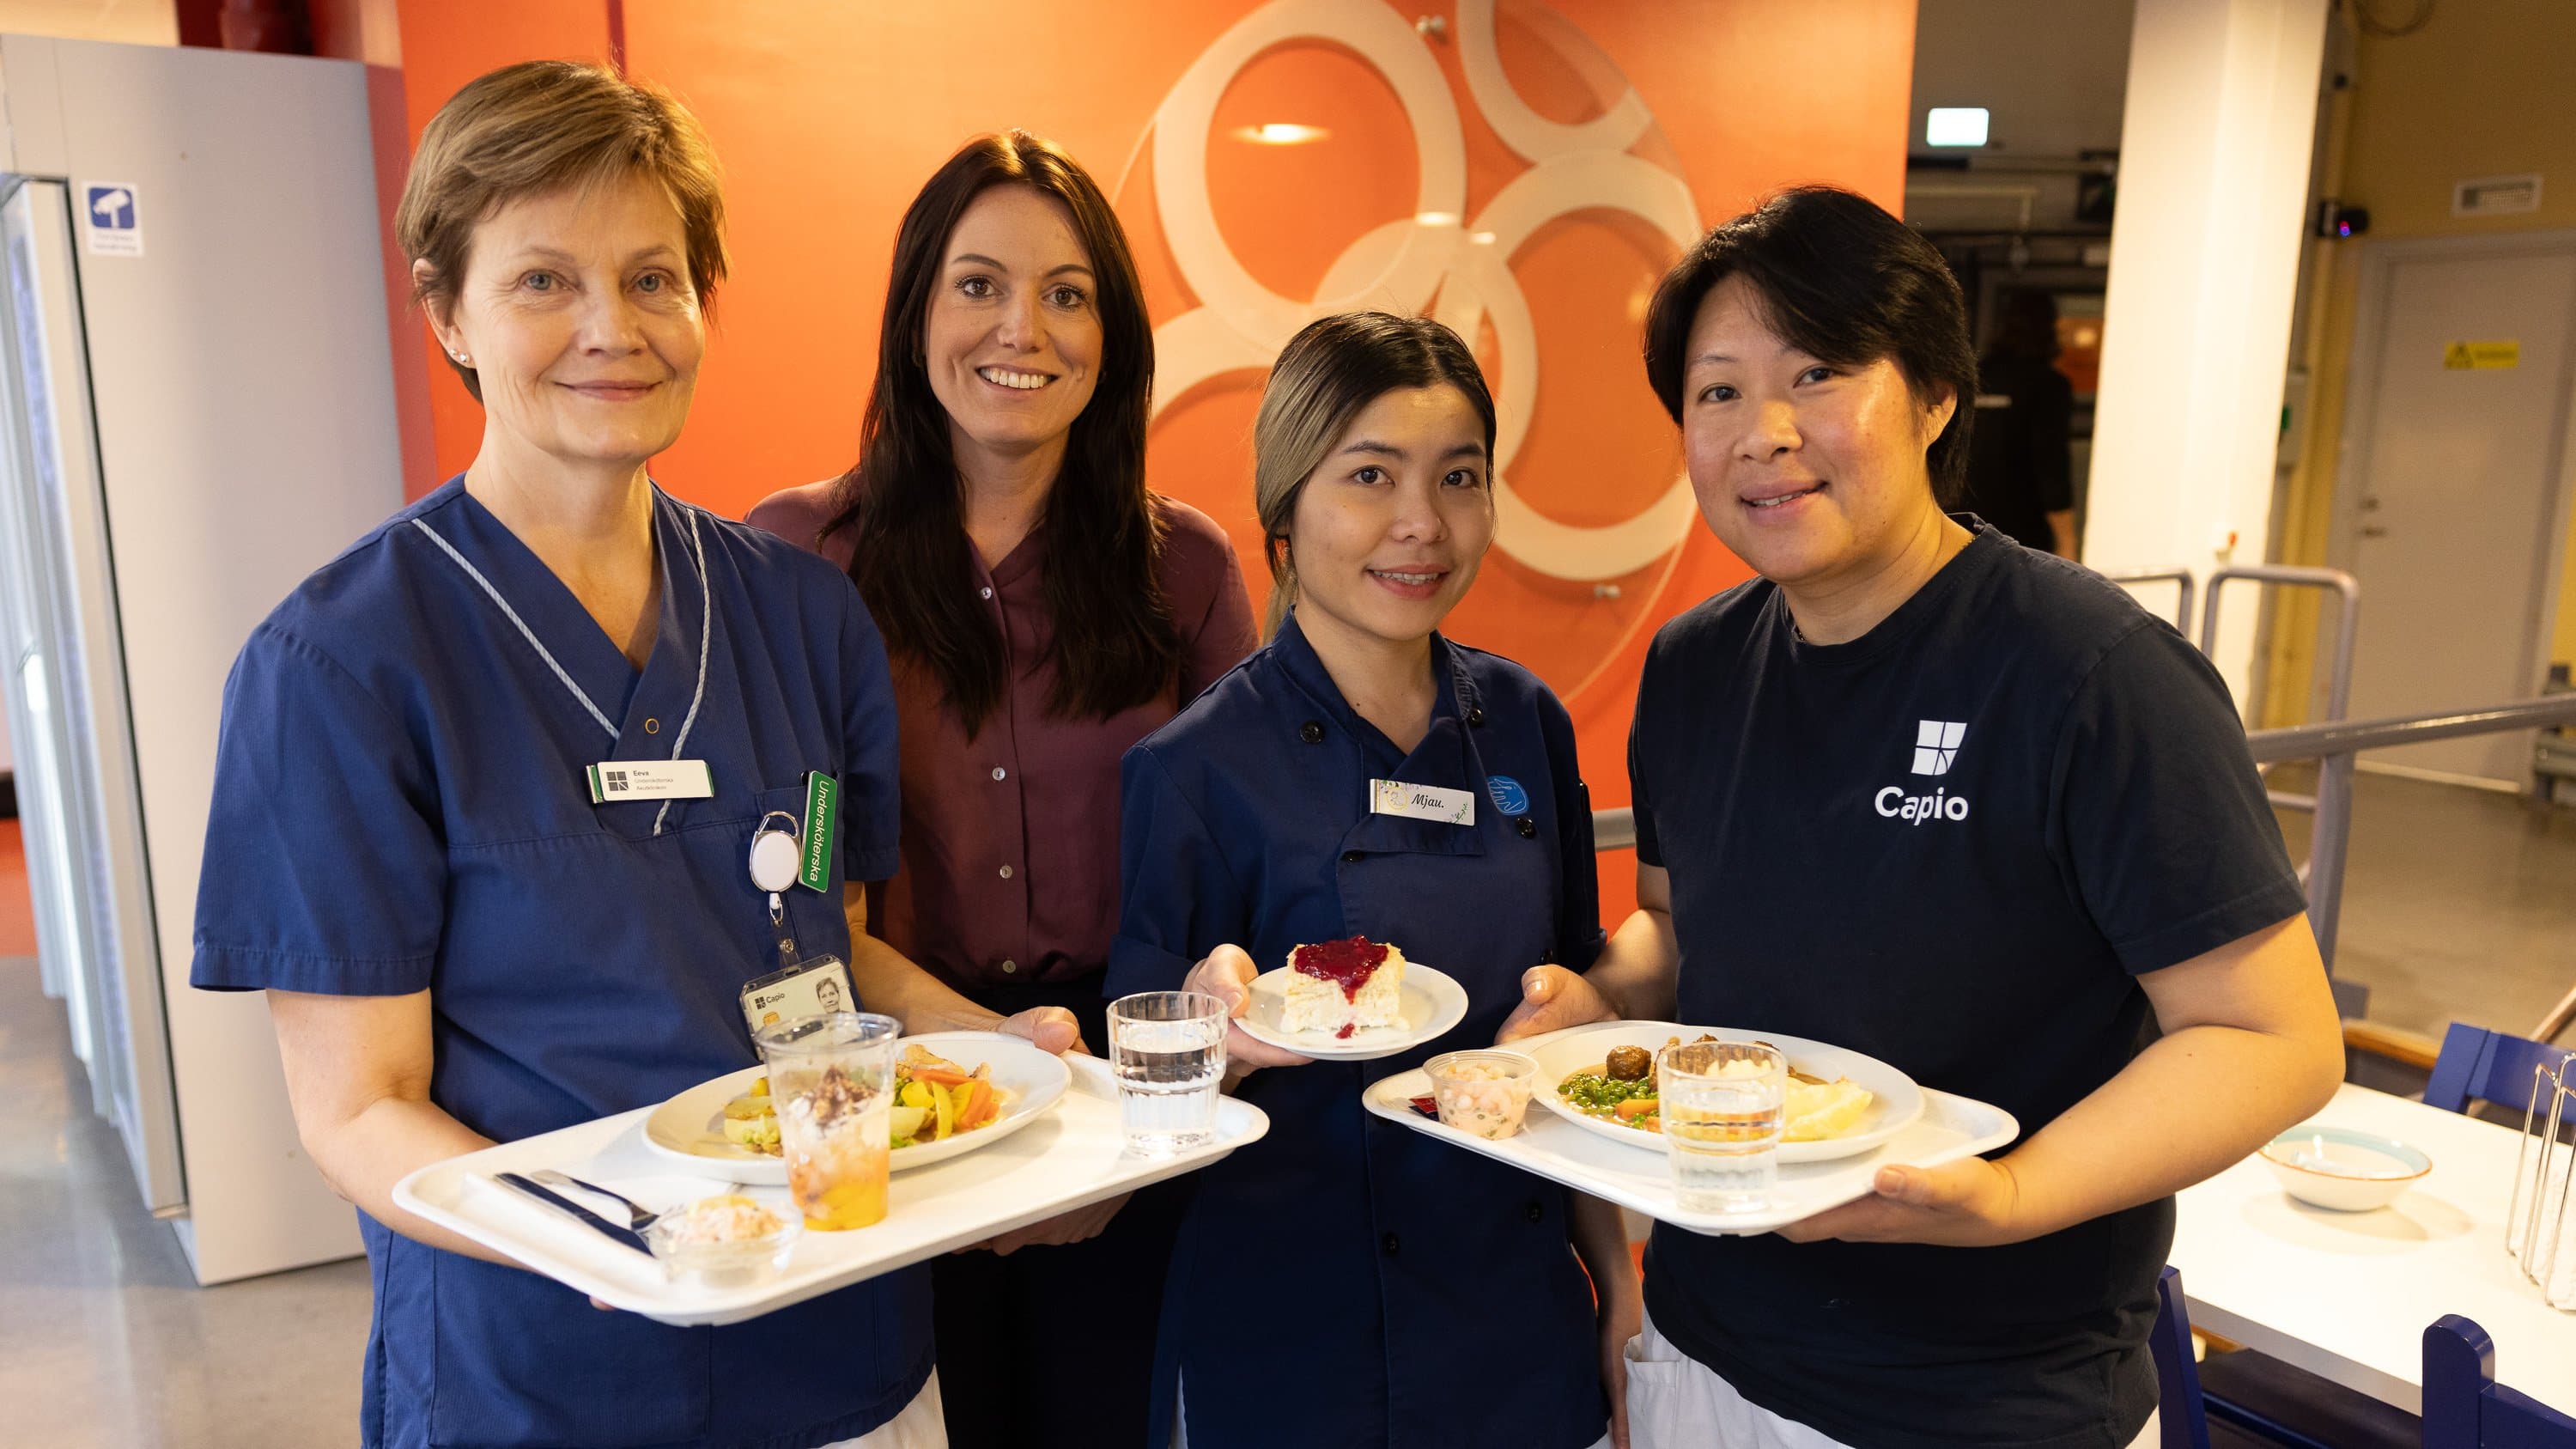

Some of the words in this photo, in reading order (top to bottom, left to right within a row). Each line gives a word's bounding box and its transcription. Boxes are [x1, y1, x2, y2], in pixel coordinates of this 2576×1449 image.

[1411, 794, 1444, 809] Mjau.
[1874, 786, 1969, 826] Capio
[810, 780, 829, 882] Undersköterska
[766, 992, 785, 1004] Capio
